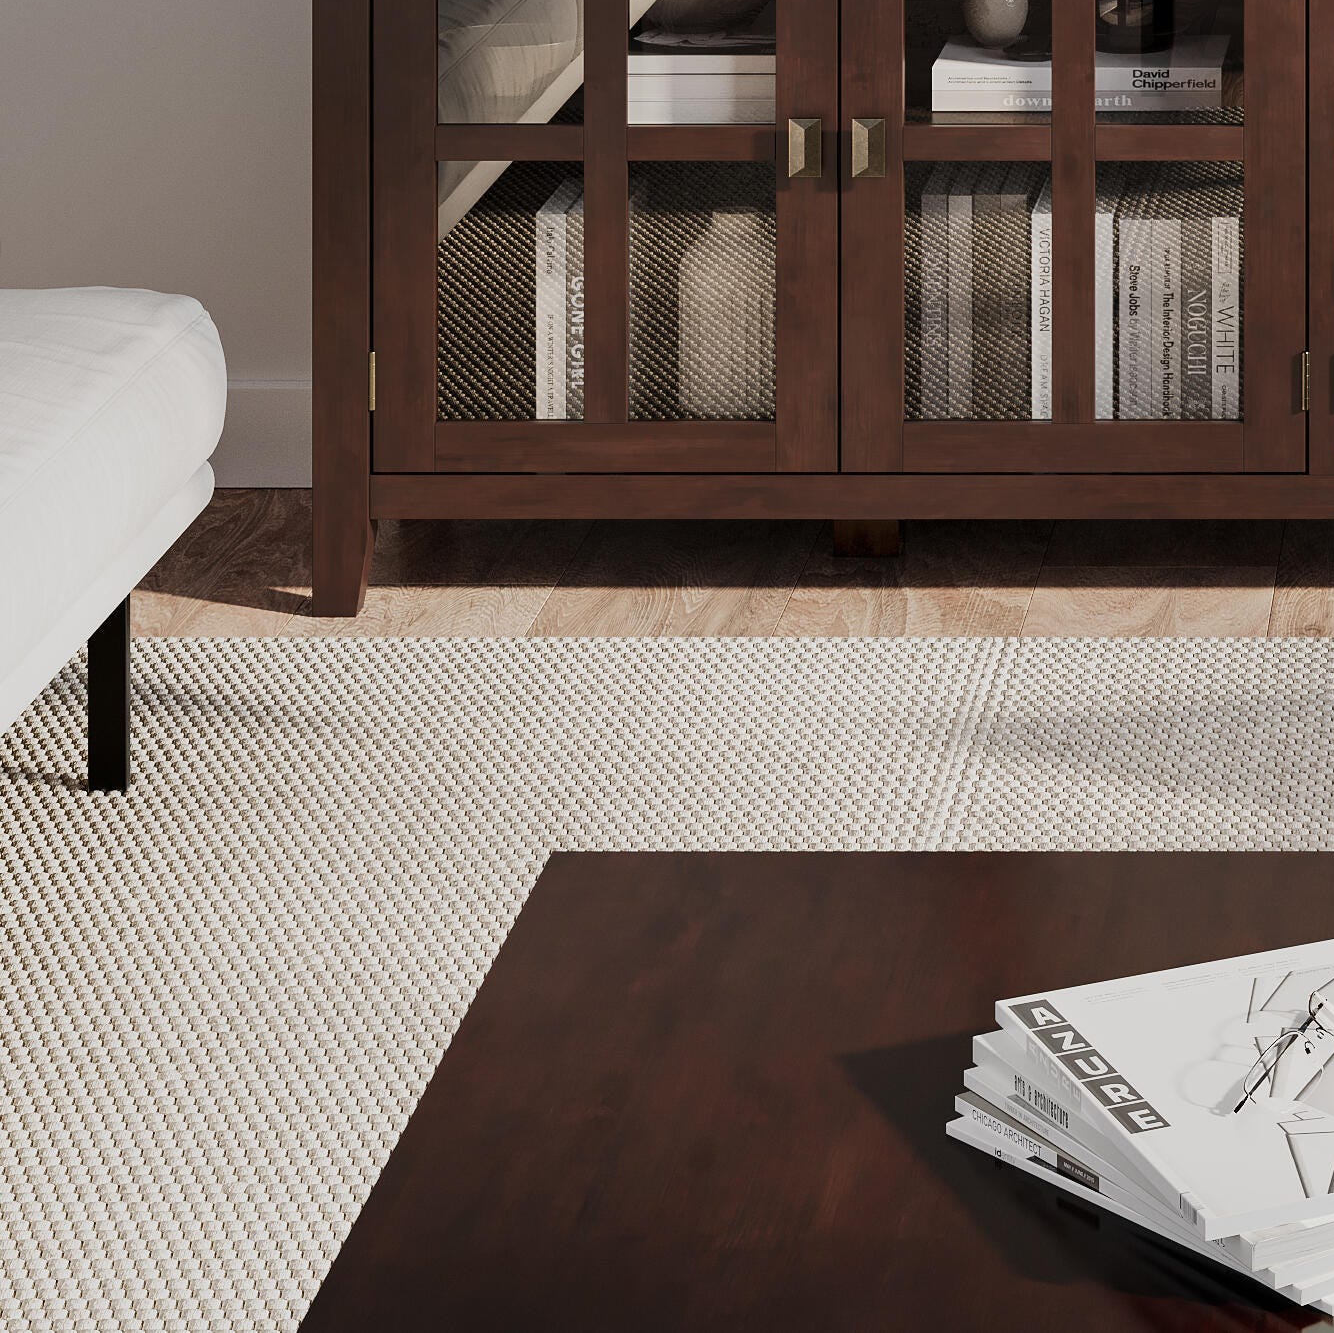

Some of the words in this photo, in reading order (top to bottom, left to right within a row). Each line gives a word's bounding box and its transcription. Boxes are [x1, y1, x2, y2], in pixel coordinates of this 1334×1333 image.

[1132, 69, 1169, 79] David
[1132, 79, 1216, 91] Chipperfield
[1003, 95, 1052, 106] down
[1095, 95, 1132, 106] arth
[1039, 228, 1050, 286] VICTORIA
[1129, 265, 1140, 291] Steve
[1039, 290, 1050, 332] HAGAN
[1129, 293, 1140, 316] Jobs
[1163, 292, 1174, 307] The
[1163, 309, 1174, 340] Interior
[1187, 289, 1207, 375] NOGUCHI
[1216, 306, 1234, 373] WHITE
[1160, 342, 1174, 370] Design
[1029, 1006, 1165, 1130] AZURE
[1015, 1075, 1025, 1096] arts
[1035, 1089, 1068, 1128] architecture
[972, 1110, 1002, 1134] CHICAGO
[1004, 1127, 1041, 1156] ARCHITECT
